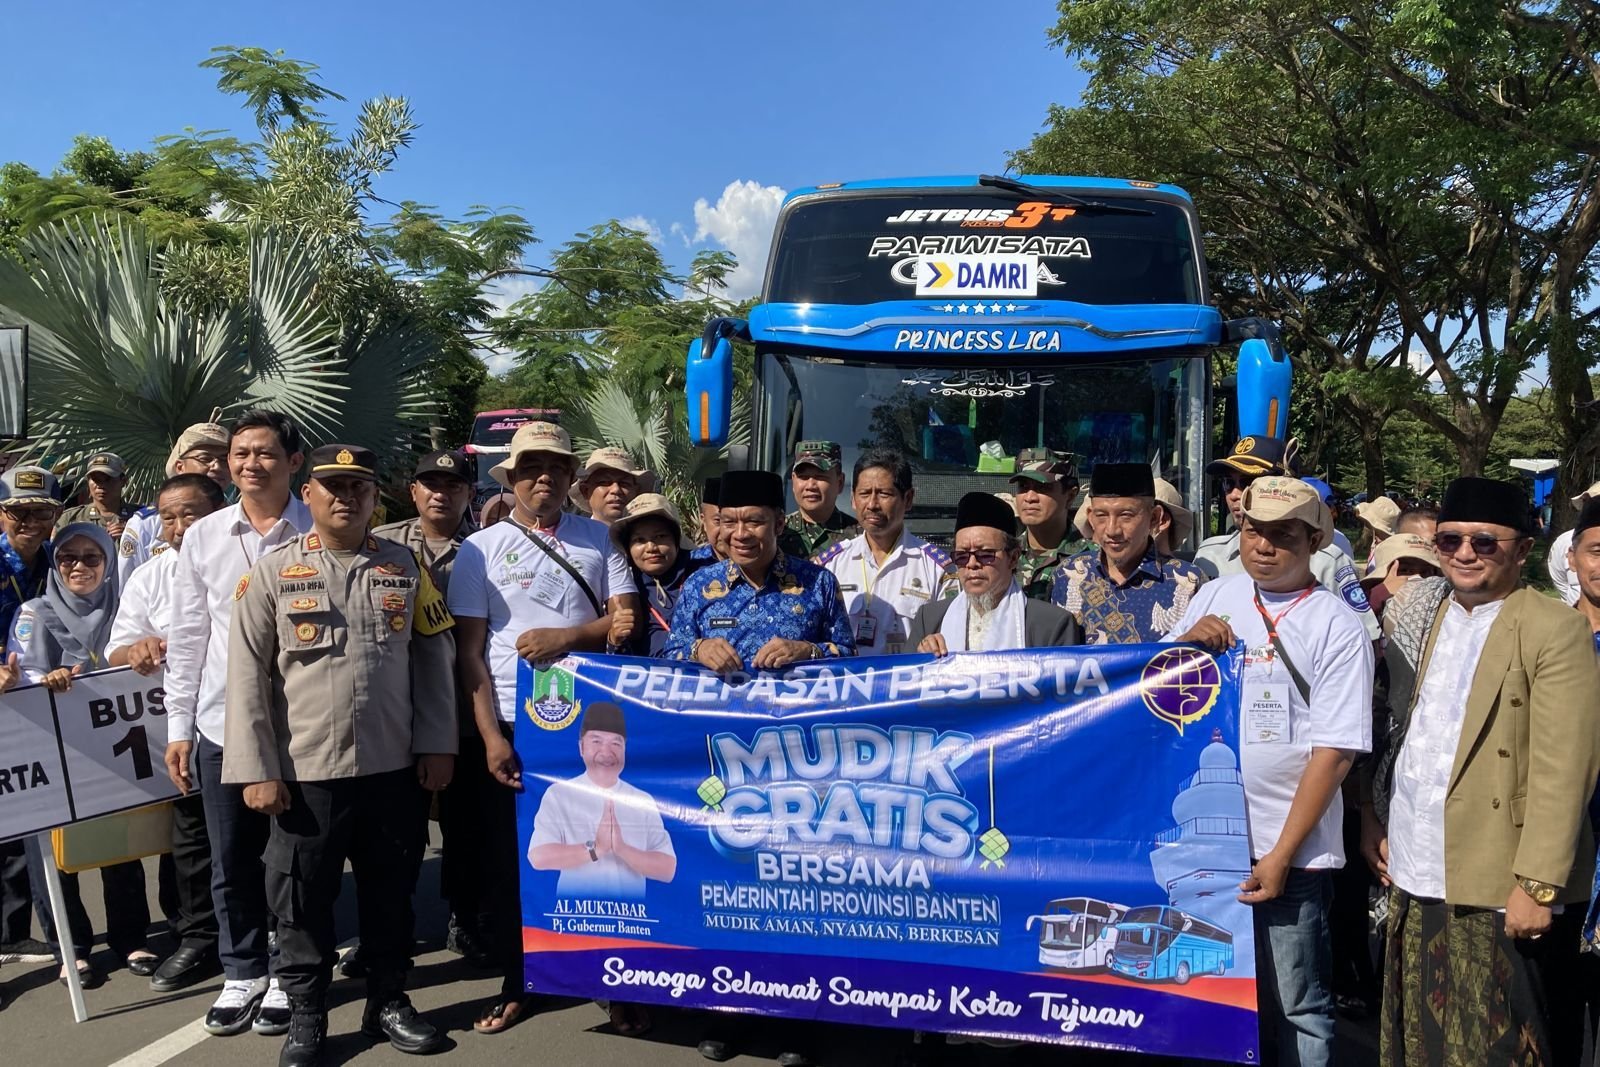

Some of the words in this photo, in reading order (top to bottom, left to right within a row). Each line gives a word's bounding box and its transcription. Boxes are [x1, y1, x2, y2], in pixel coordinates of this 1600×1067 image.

[886, 208, 1014, 222] JETBUS
[868, 235, 1092, 258] PARIWISATA
[957, 262, 1027, 289] DAMRI
[895, 329, 1003, 350] PRINCESS
[1008, 330, 1061, 351] LICA
[279, 582, 306, 593] AHMAD
[307, 580, 325, 591] RIFAI
[371, 577, 412, 589] POLRI
[613, 663, 875, 702] PELEPASAN
[888, 657, 1110, 701] PESERTA
[88, 687, 168, 729] BUS
[112, 724, 154, 781] 1
[712, 724, 975, 797] MUDIK
[711, 781, 979, 862] GRATIS
[757, 852, 931, 890] BERSAMA
[554, 899, 573, 914] AL
[575, 901, 647, 919] MUKTABAR
[702, 884, 816, 912] PEMERINTAH
[820, 890, 911, 918] PROVINSI
[916, 896, 999, 923] BANTEN
[552, 918, 566, 935] Pj.
[567, 919, 616, 933] Gubernur
[618, 922, 651, 936] Banten
[705, 913, 760, 931] MUDIK
[764, 917, 819, 937] AMAN,
[822, 920, 903, 942] NYAMAN,
[908, 927, 1000, 946] BERKESAN
[602, 956, 706, 998] Semoga
[712, 966, 822, 1002] Selamat
[828, 976, 942, 1018] Sampai
[949, 985, 1022, 1018] Kota
[1029, 991, 1145, 1032] Tujuan
